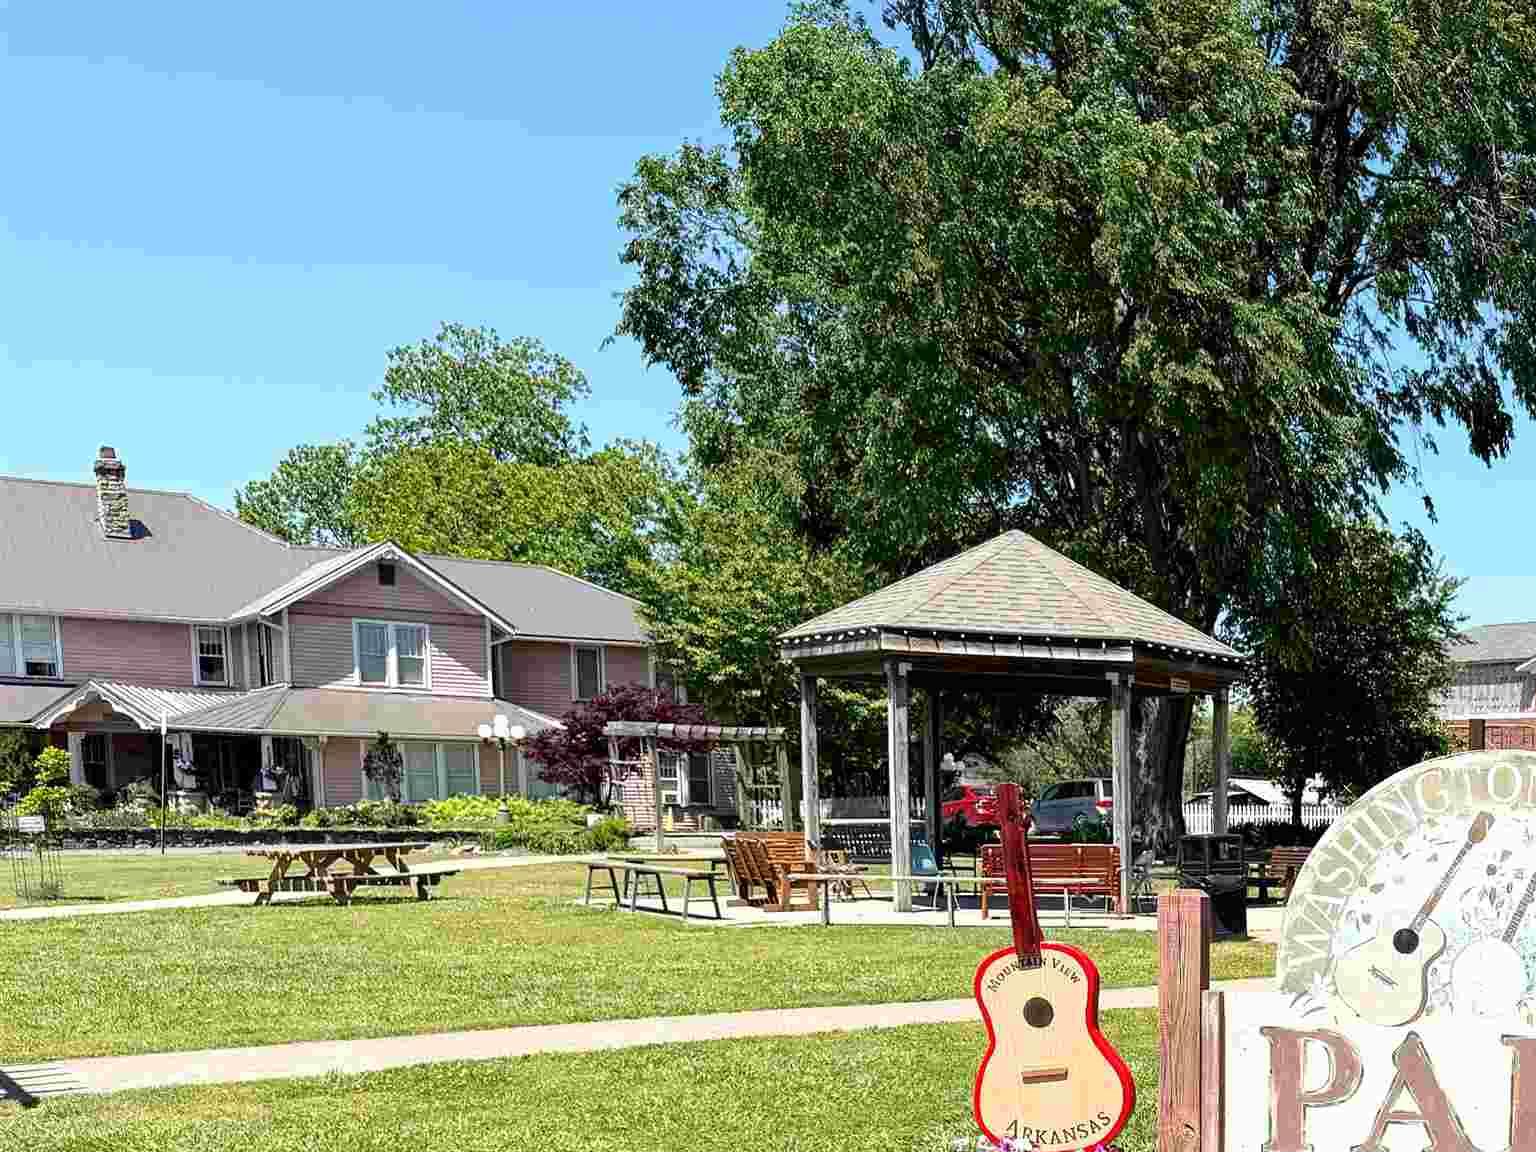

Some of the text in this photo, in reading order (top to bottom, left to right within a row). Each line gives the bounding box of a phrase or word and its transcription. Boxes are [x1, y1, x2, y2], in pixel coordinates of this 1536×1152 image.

[986, 957, 1081, 992] MOUNTAIN VIEW
[1006, 1111, 1112, 1145] ARKANSAS
